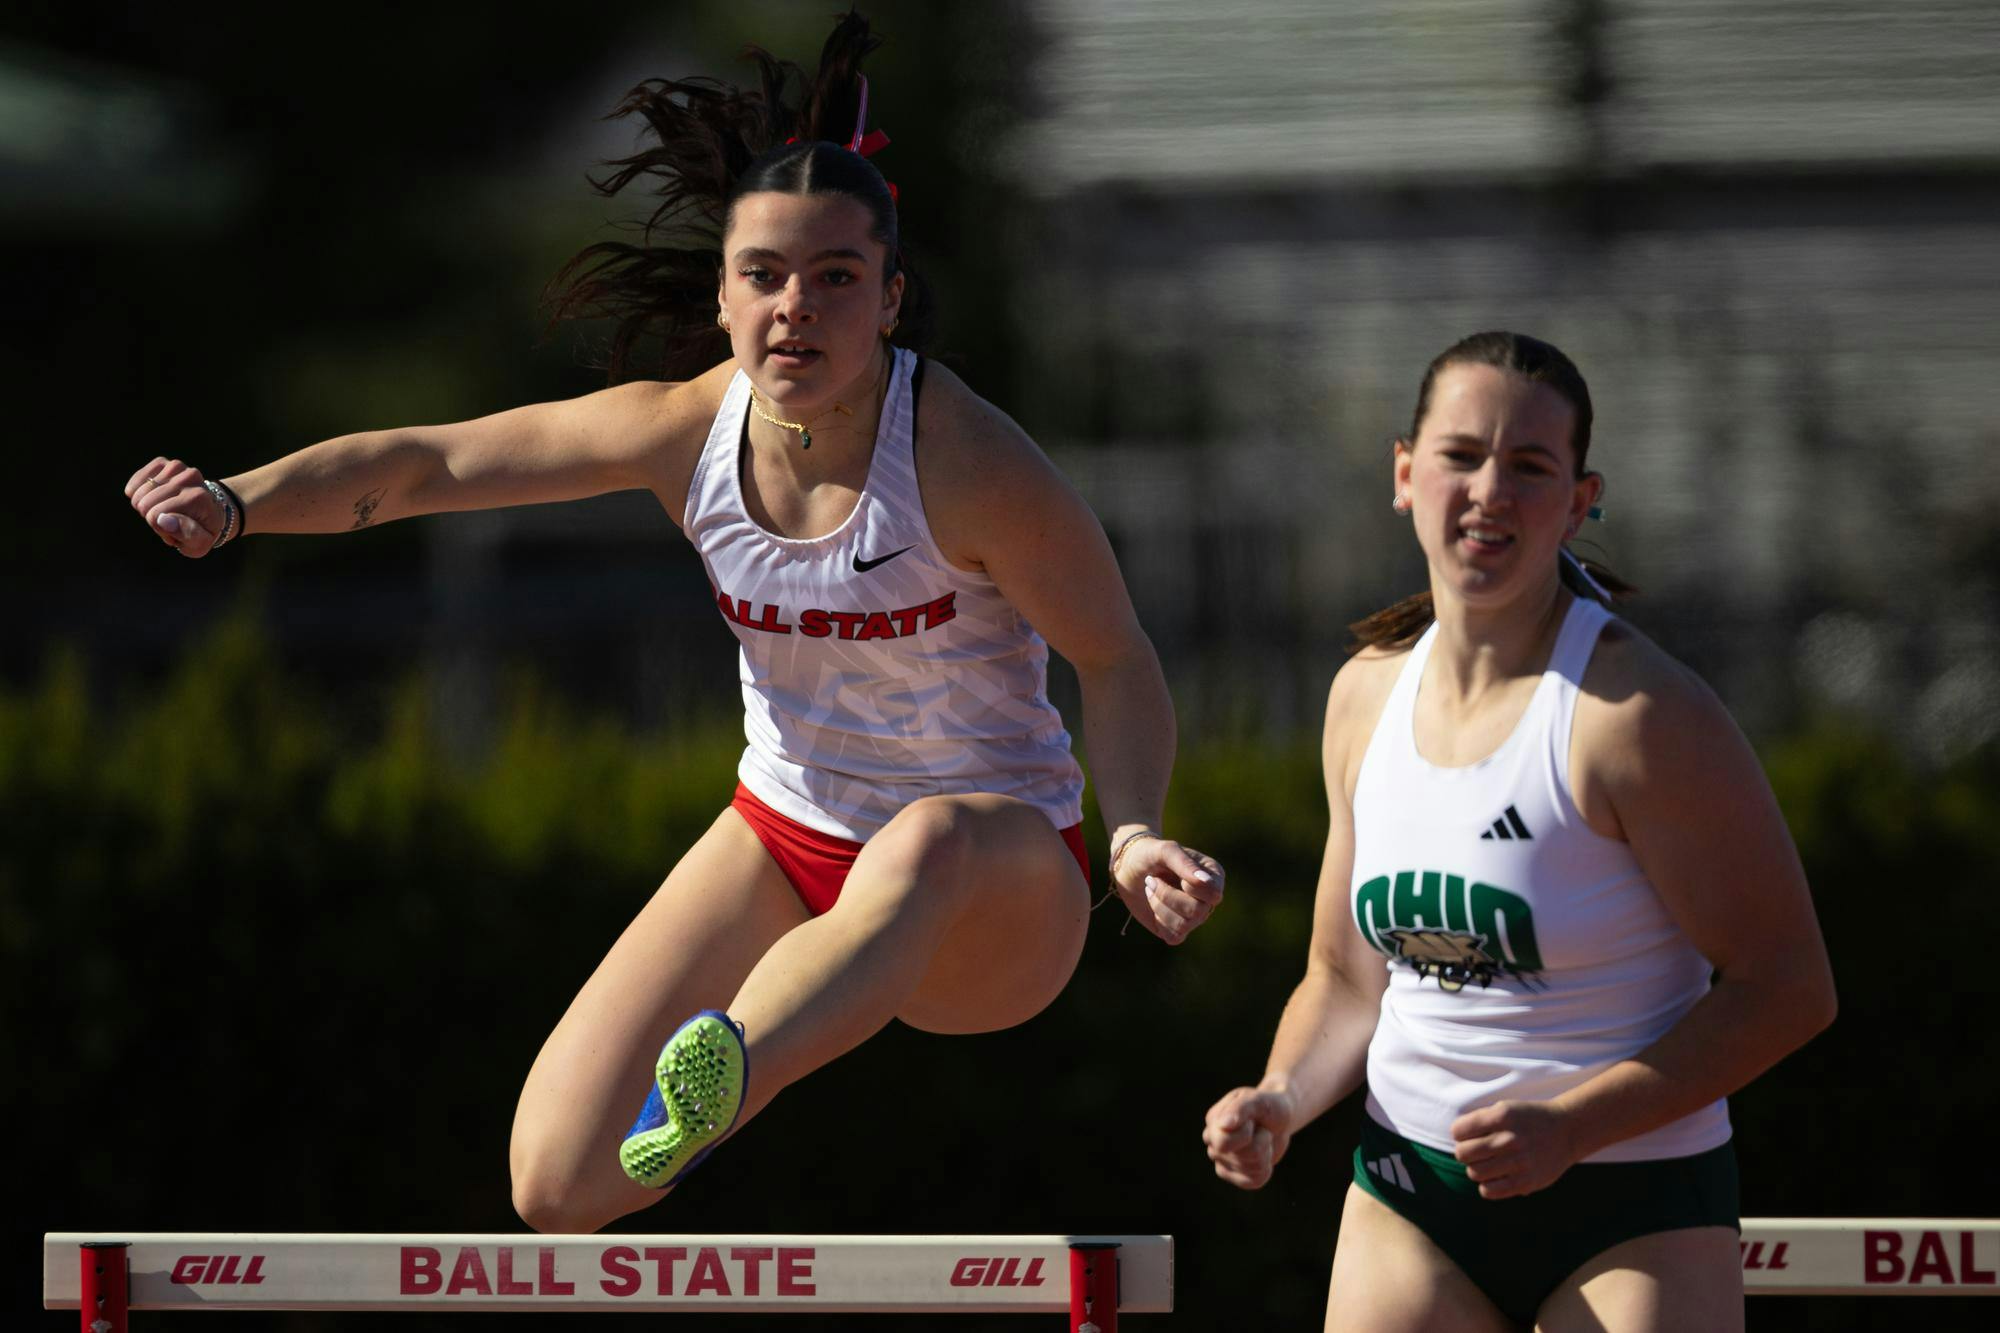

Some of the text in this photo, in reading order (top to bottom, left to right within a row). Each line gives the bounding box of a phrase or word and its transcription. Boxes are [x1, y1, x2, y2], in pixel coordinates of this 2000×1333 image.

[710, 583, 956, 640] ALL STATE
[1357, 871, 1544, 973] OHIO
[170, 1255, 266, 1285] GILL
[400, 1245, 816, 1297] BALL STATE
[949, 1257, 1046, 1287] GILL
[1740, 1241, 1789, 1269] LL
